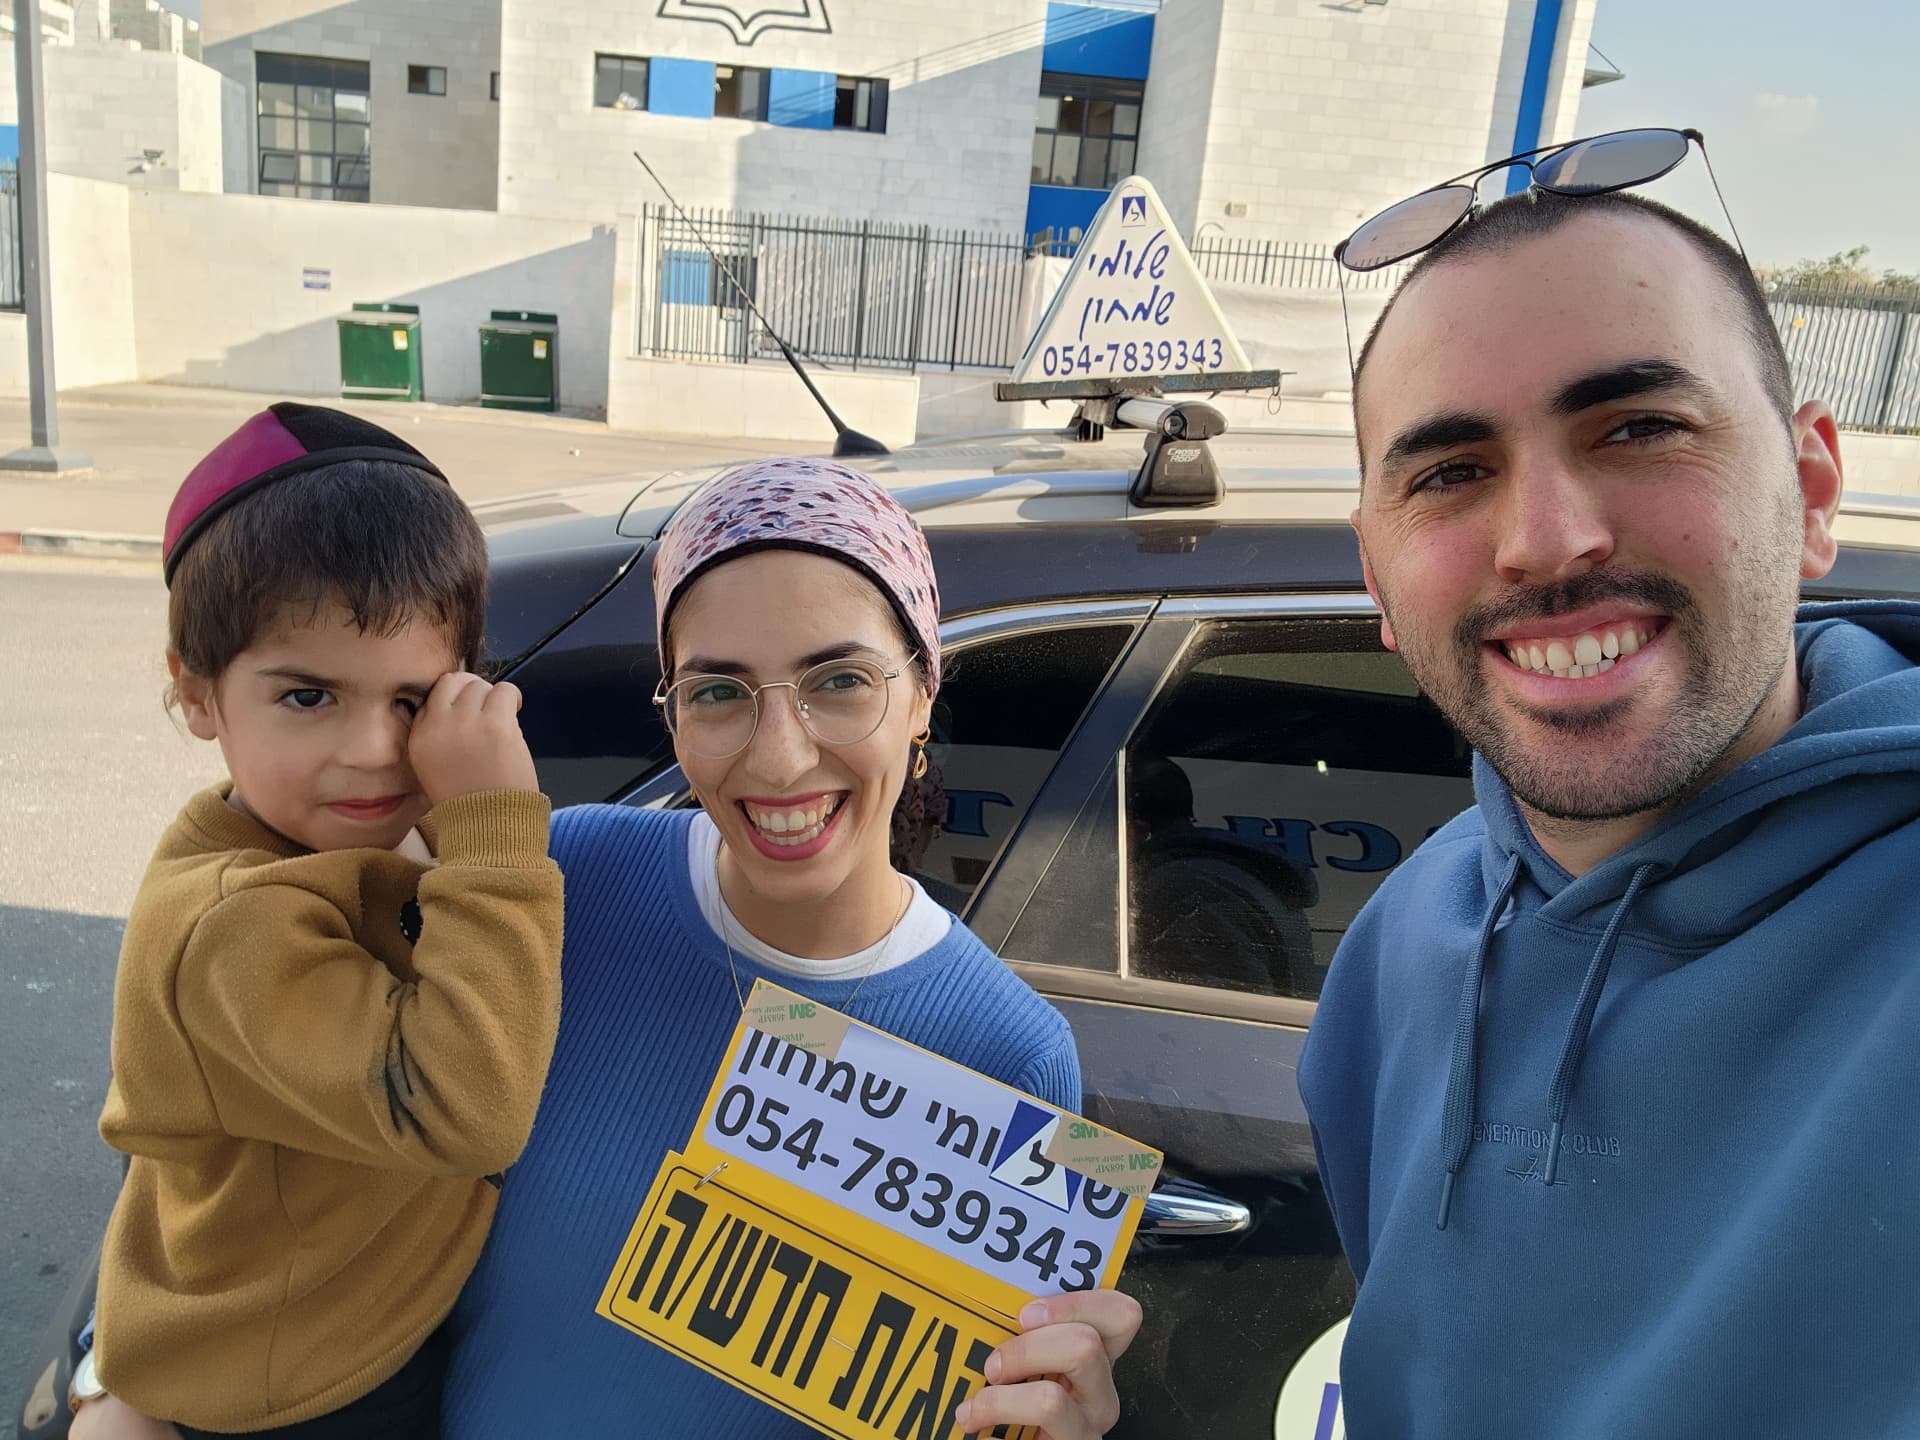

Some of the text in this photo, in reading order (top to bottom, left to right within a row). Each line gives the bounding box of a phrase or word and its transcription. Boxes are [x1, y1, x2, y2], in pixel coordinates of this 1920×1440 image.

[1087, 228, 1170, 280] שלומי
[1078, 284, 1176, 342] שמחון
[1042, 337, 1224, 376] 054-7839343
[788, 1002, 817, 1020] 3M
[1128, 1152, 1159, 1171] 3M
[714, 1084, 1103, 1293] 054-7839343
[627, 1189, 853, 1390] חדש/ה
